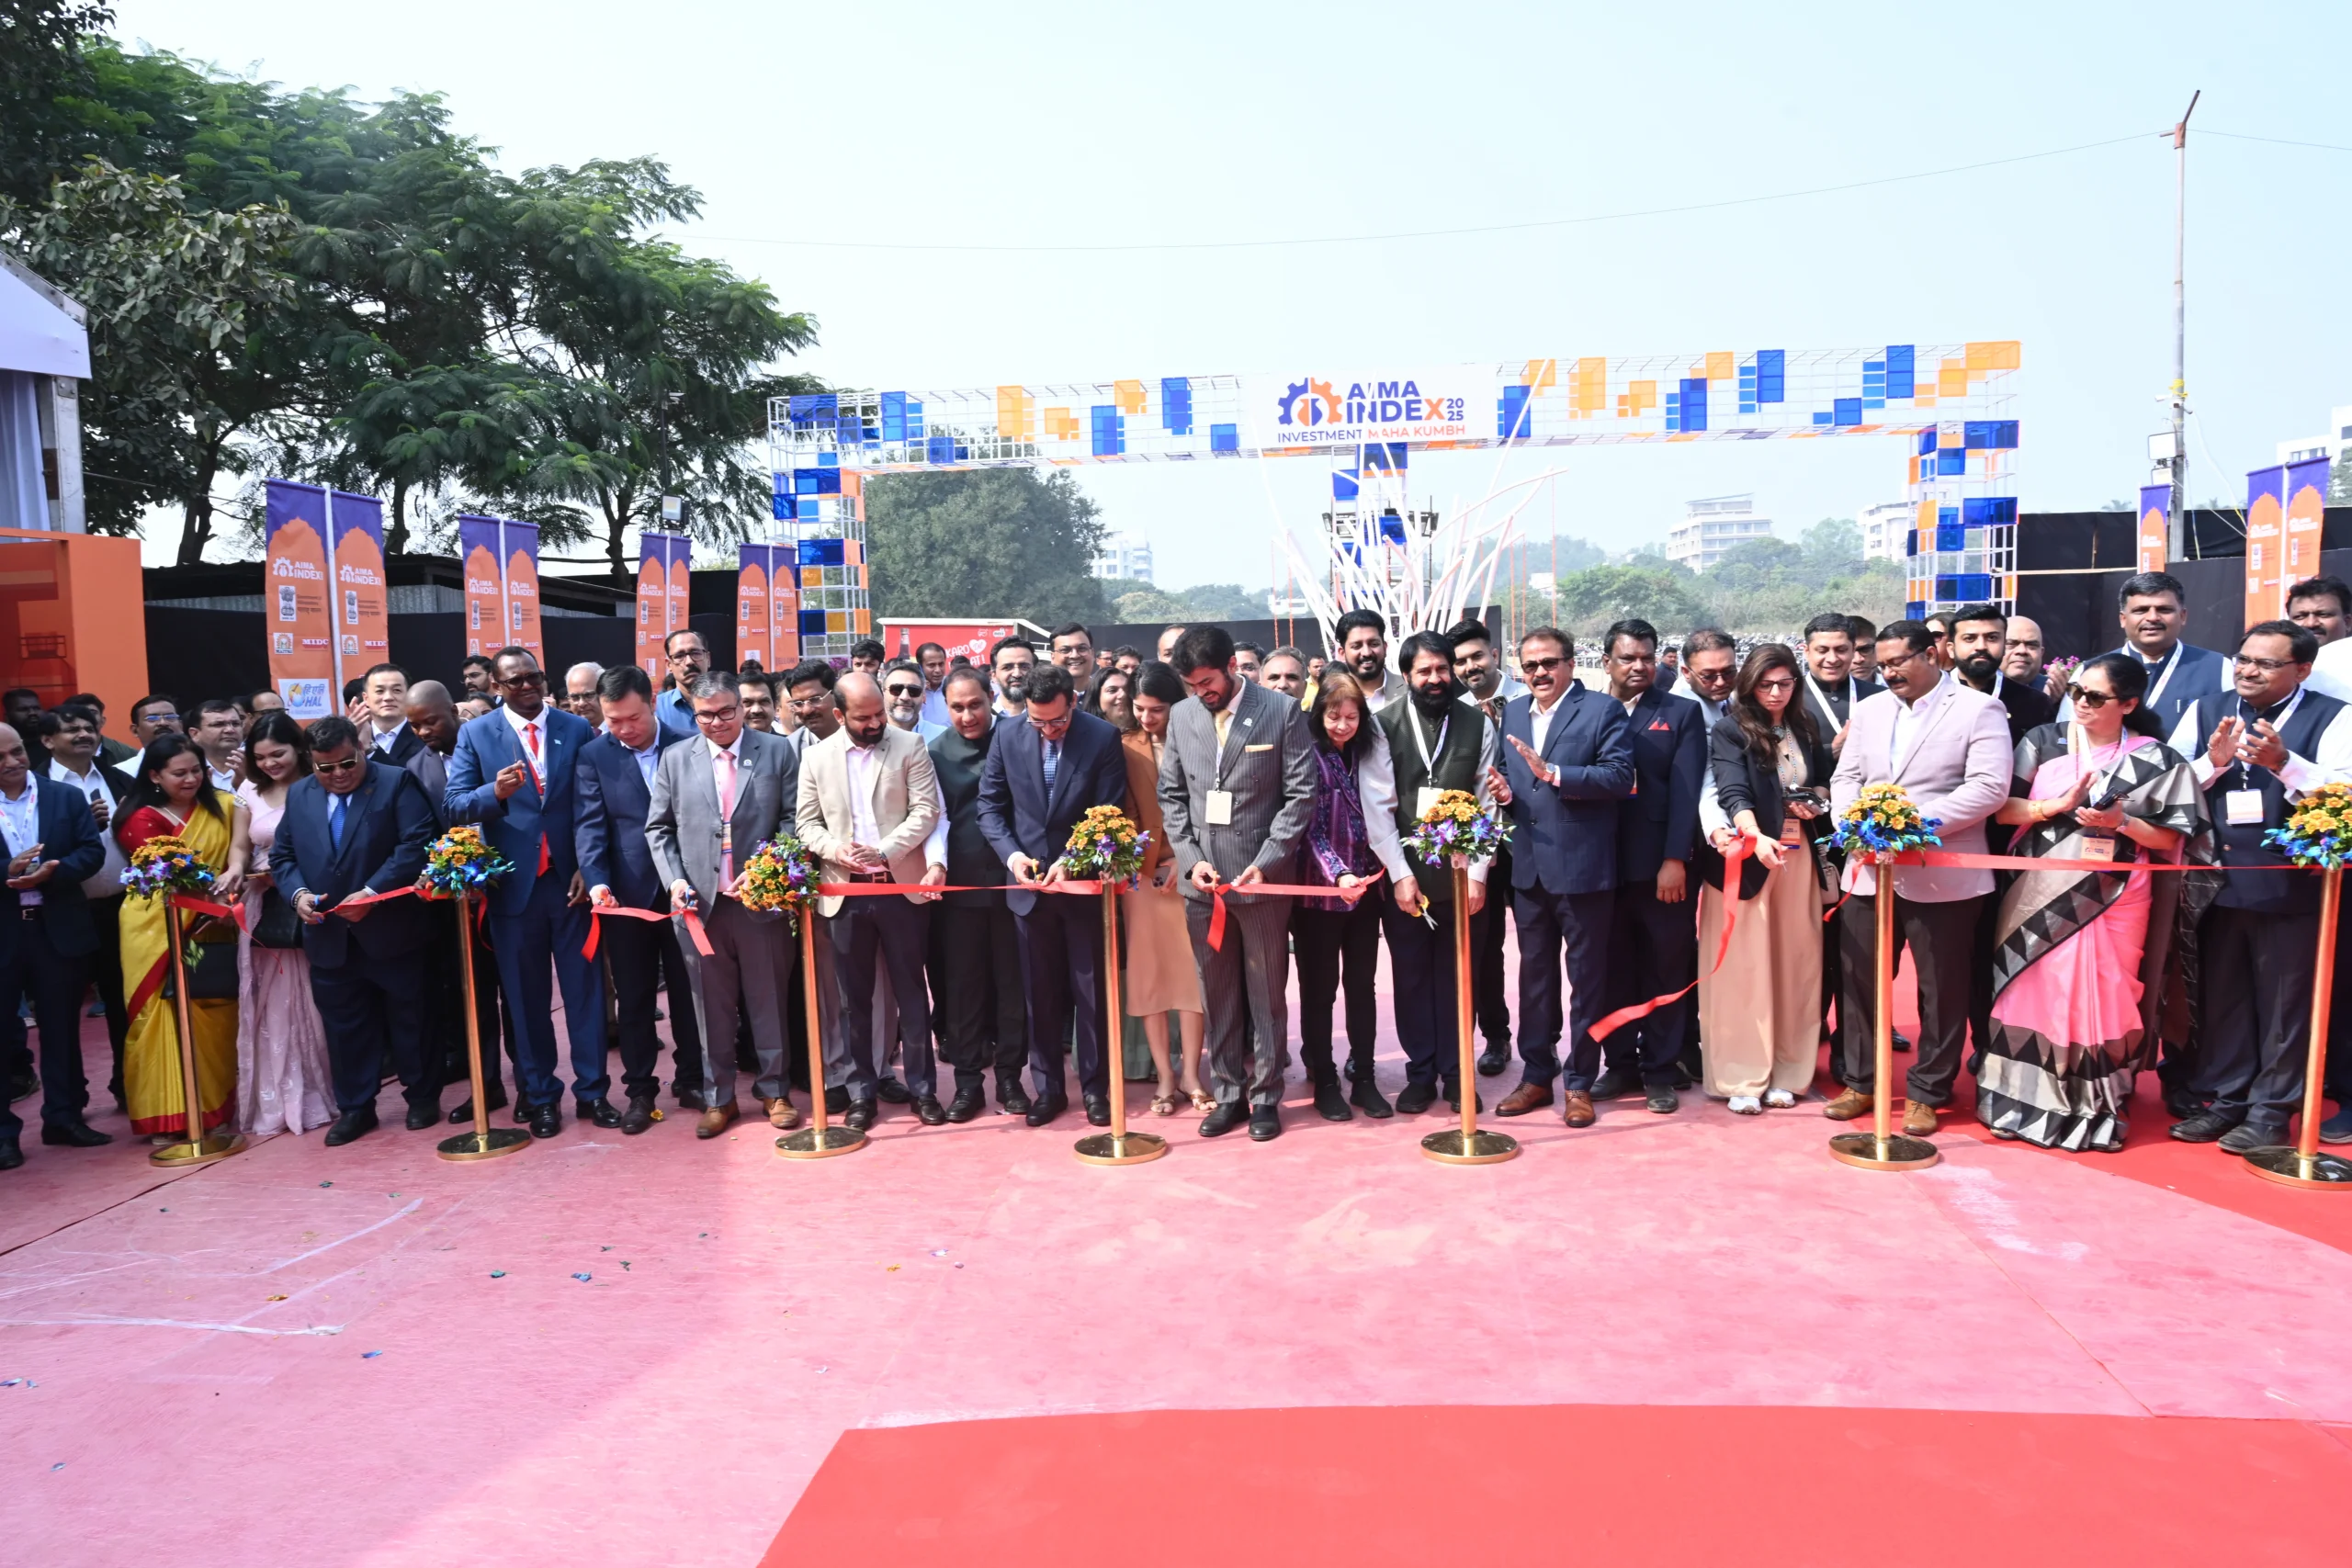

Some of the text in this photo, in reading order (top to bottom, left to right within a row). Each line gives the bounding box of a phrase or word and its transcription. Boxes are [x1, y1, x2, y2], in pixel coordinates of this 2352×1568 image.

[1446, 398, 1464, 409] 20
[1346, 397, 1445, 424] INDEX
[1447, 410, 1464, 422] 25
[1278, 424, 1465, 443] INVESTMENT MAHA KUMBH
[294, 561, 315, 570] AIMA
[294, 570, 322, 580] INDEX
[355, 568, 374, 576] AIMA
[355, 575, 379, 585] INDEX
[945, 644, 970, 658] KARO
[304, 696, 322, 706] HAL
